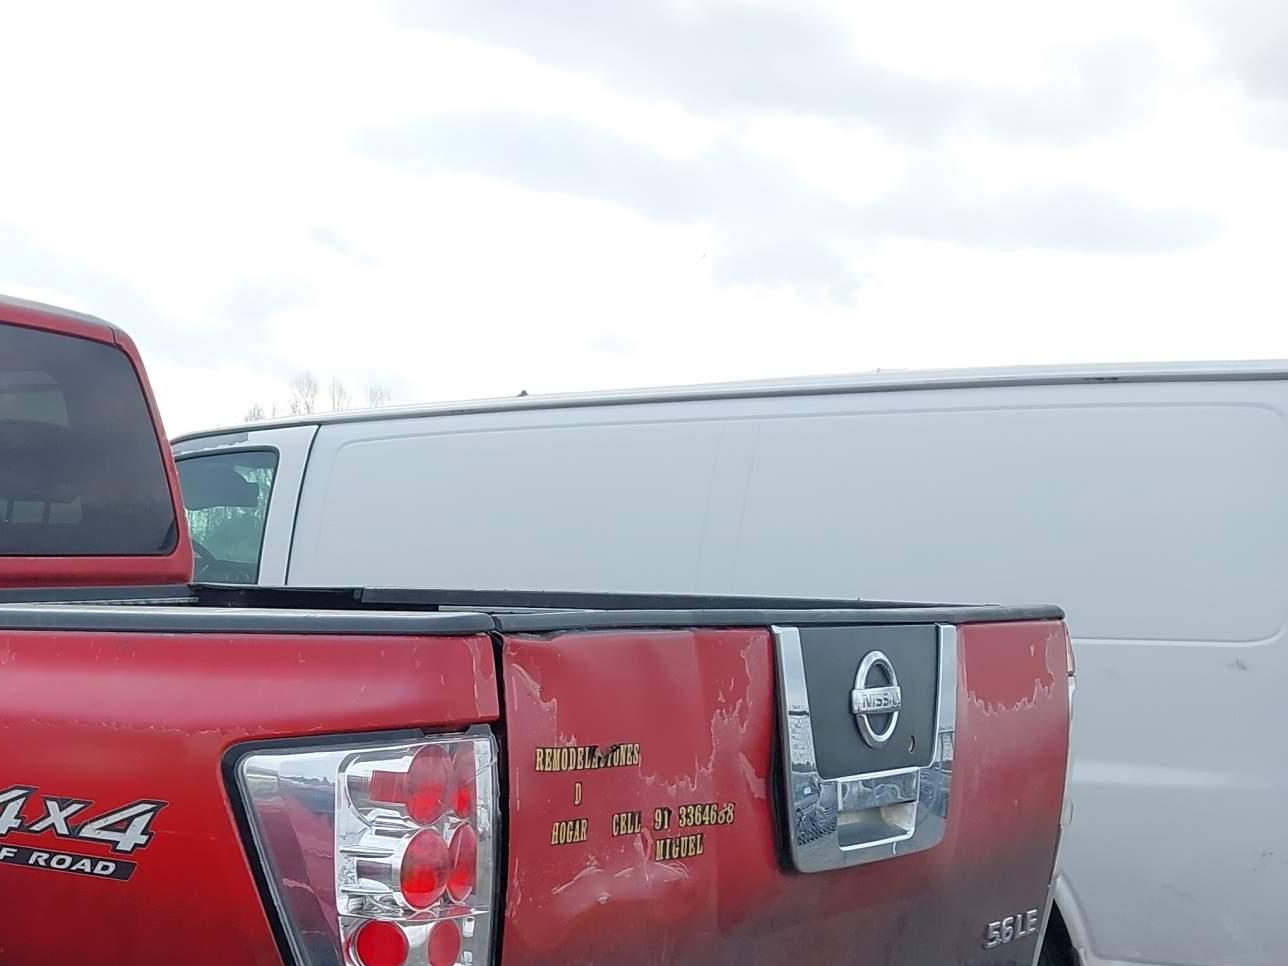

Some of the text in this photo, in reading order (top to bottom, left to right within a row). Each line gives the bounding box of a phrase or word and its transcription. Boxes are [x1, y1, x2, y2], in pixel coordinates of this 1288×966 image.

[575, 782, 582, 805] D
[551, 819, 588, 845] HOGAR
[612, 810, 641, 837] CELL
[655, 834, 703, 861] MIGUEL
[28, 852, 116, 876] ROAD
